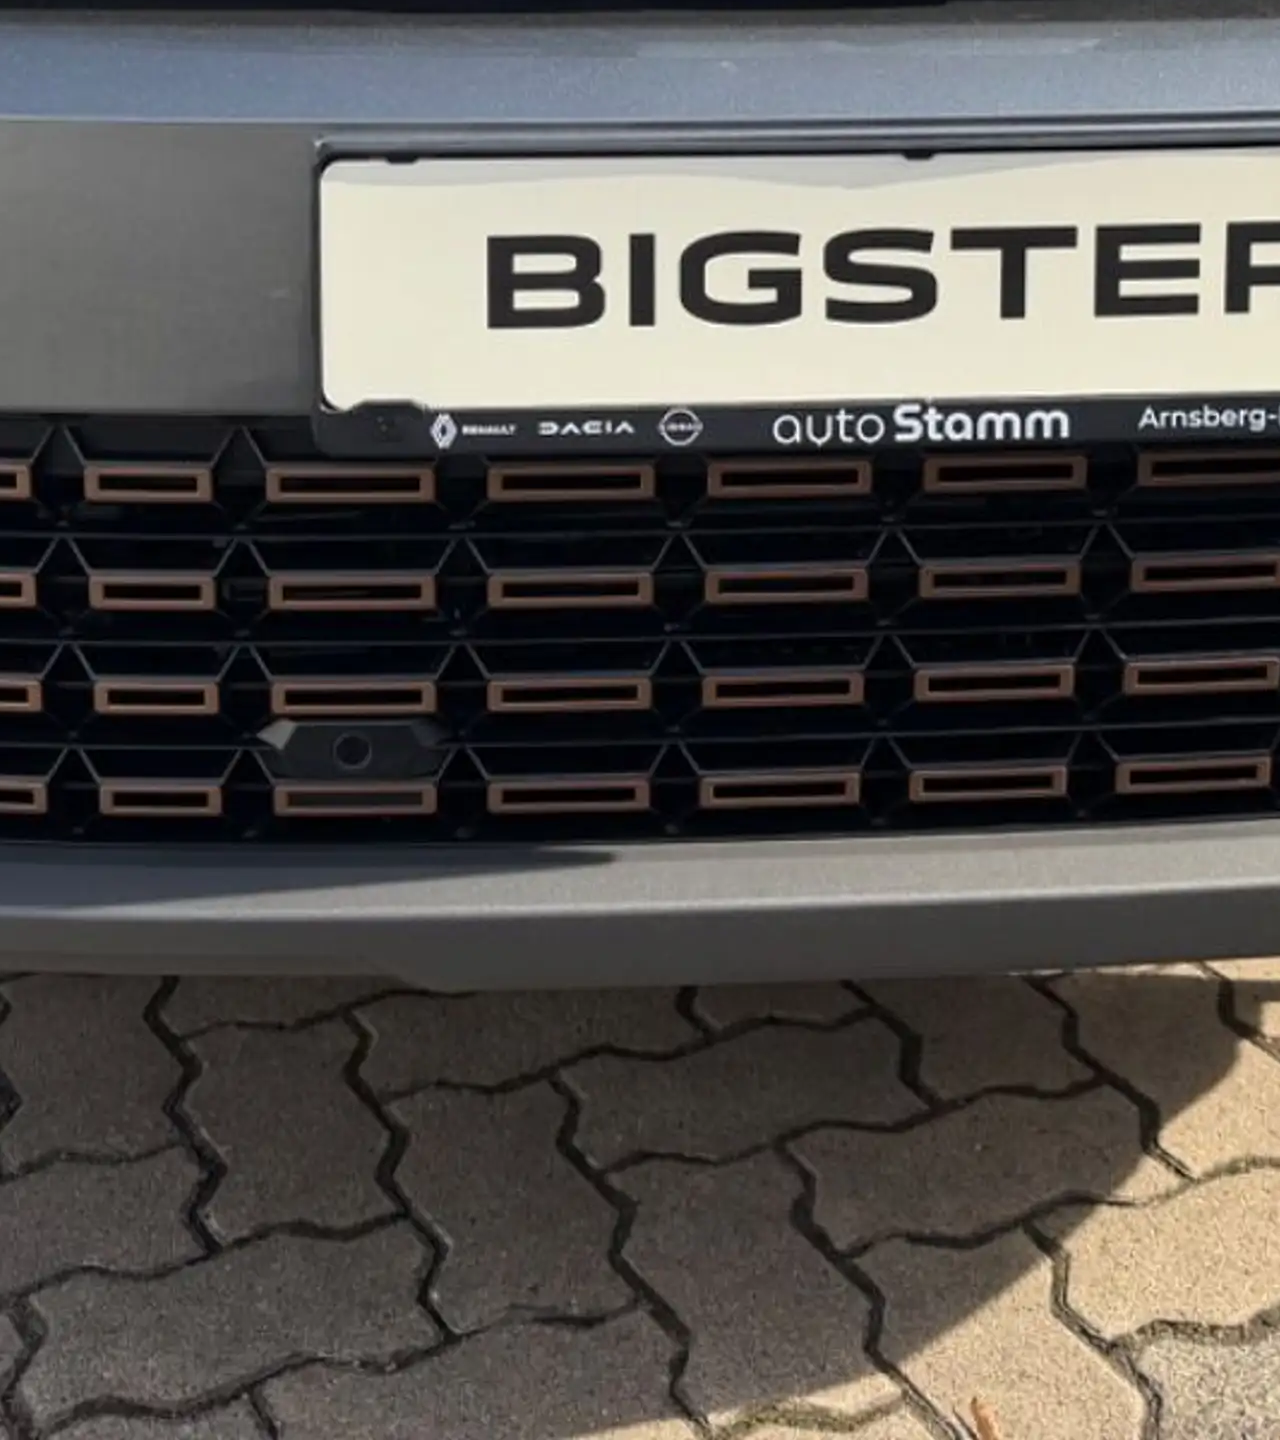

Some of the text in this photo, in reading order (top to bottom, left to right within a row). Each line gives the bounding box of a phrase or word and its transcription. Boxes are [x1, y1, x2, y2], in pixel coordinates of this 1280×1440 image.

[537, 420, 635, 435] DACIA
[772, 403, 1070, 446] auto Stamm
